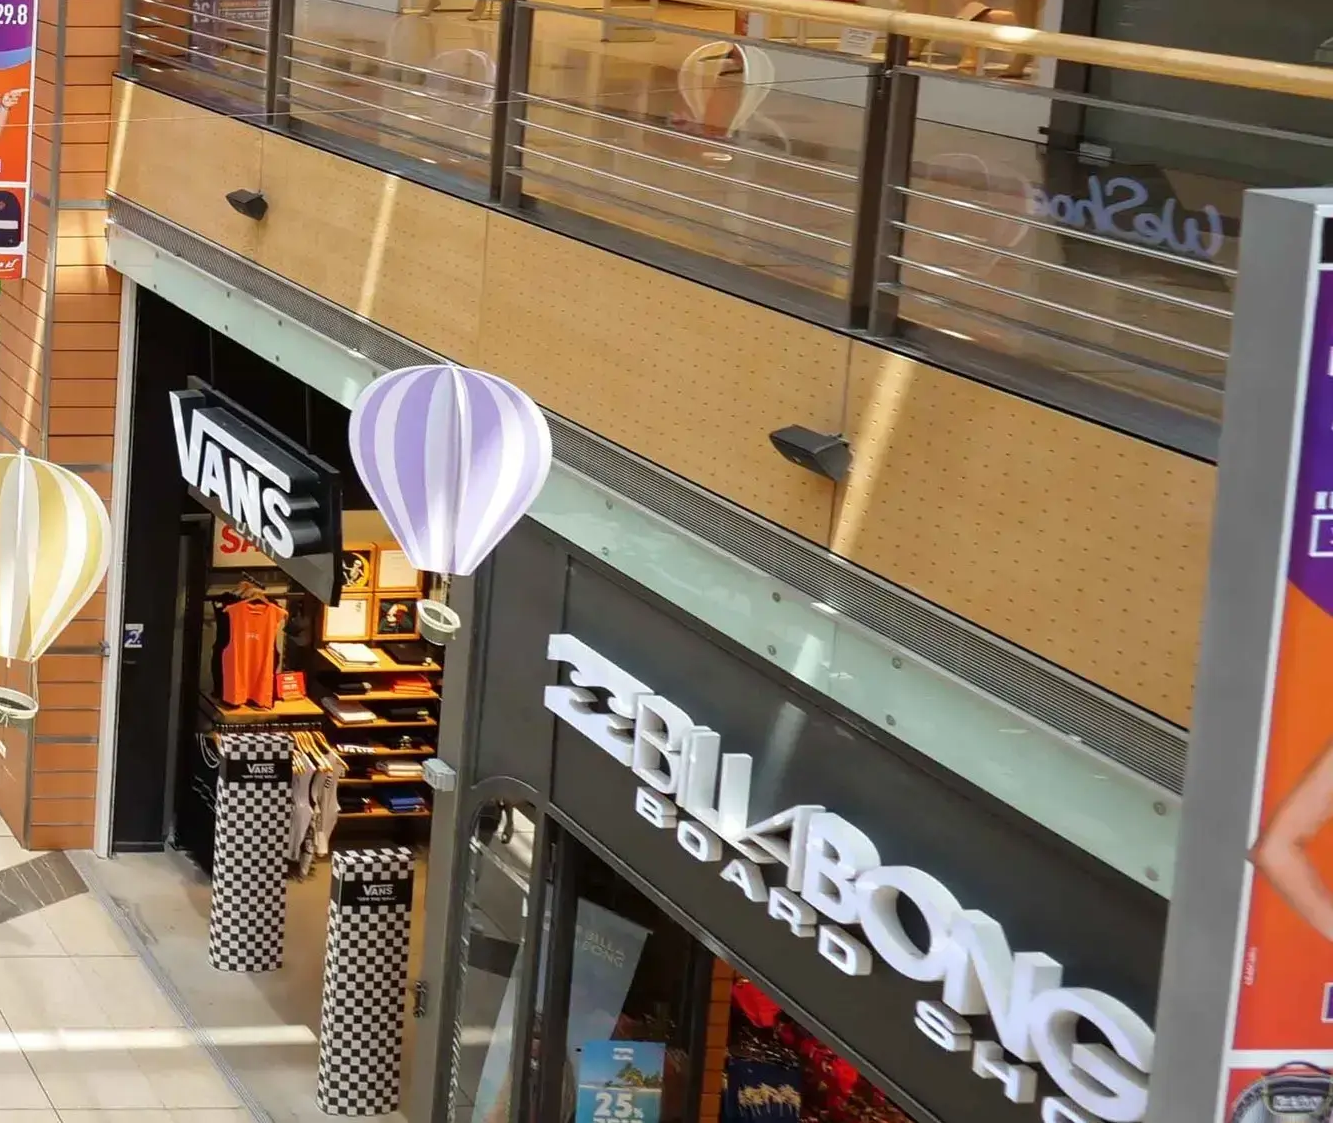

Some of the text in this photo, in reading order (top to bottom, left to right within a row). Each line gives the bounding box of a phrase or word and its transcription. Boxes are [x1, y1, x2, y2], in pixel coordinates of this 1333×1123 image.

[169, 389, 295, 561] VANS
[246, 763, 275, 774] VANS
[362, 884, 394, 896] VANS
[630, 691, 1157, 1123] BILLABONG
[635, 786, 1108, 1123] BOARD SH
[593, 1091, 645, 1119] 25%
